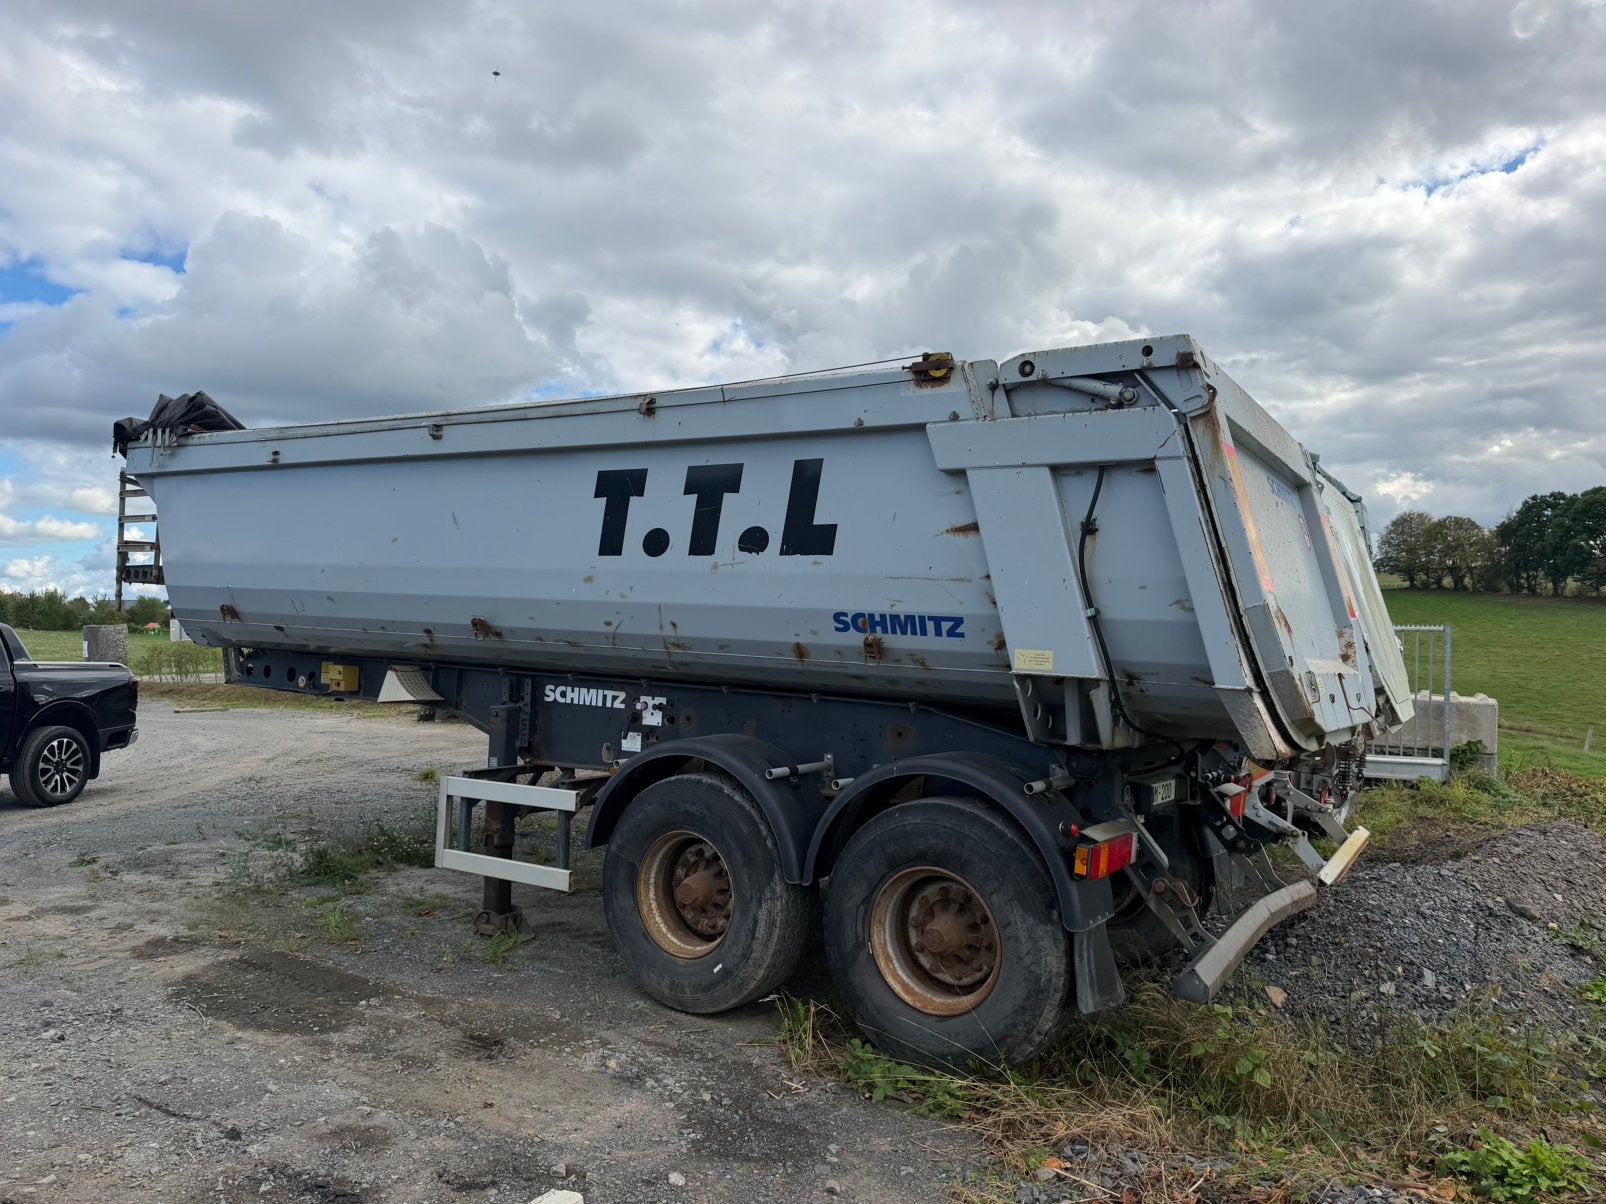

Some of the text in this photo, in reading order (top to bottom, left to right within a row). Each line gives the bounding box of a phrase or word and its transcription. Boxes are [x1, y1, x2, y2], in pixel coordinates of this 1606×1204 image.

[594, 458, 838, 557] T.T.L
[832, 612, 966, 638] SCHMITZ
[544, 685, 627, 708] SCHMITZ
